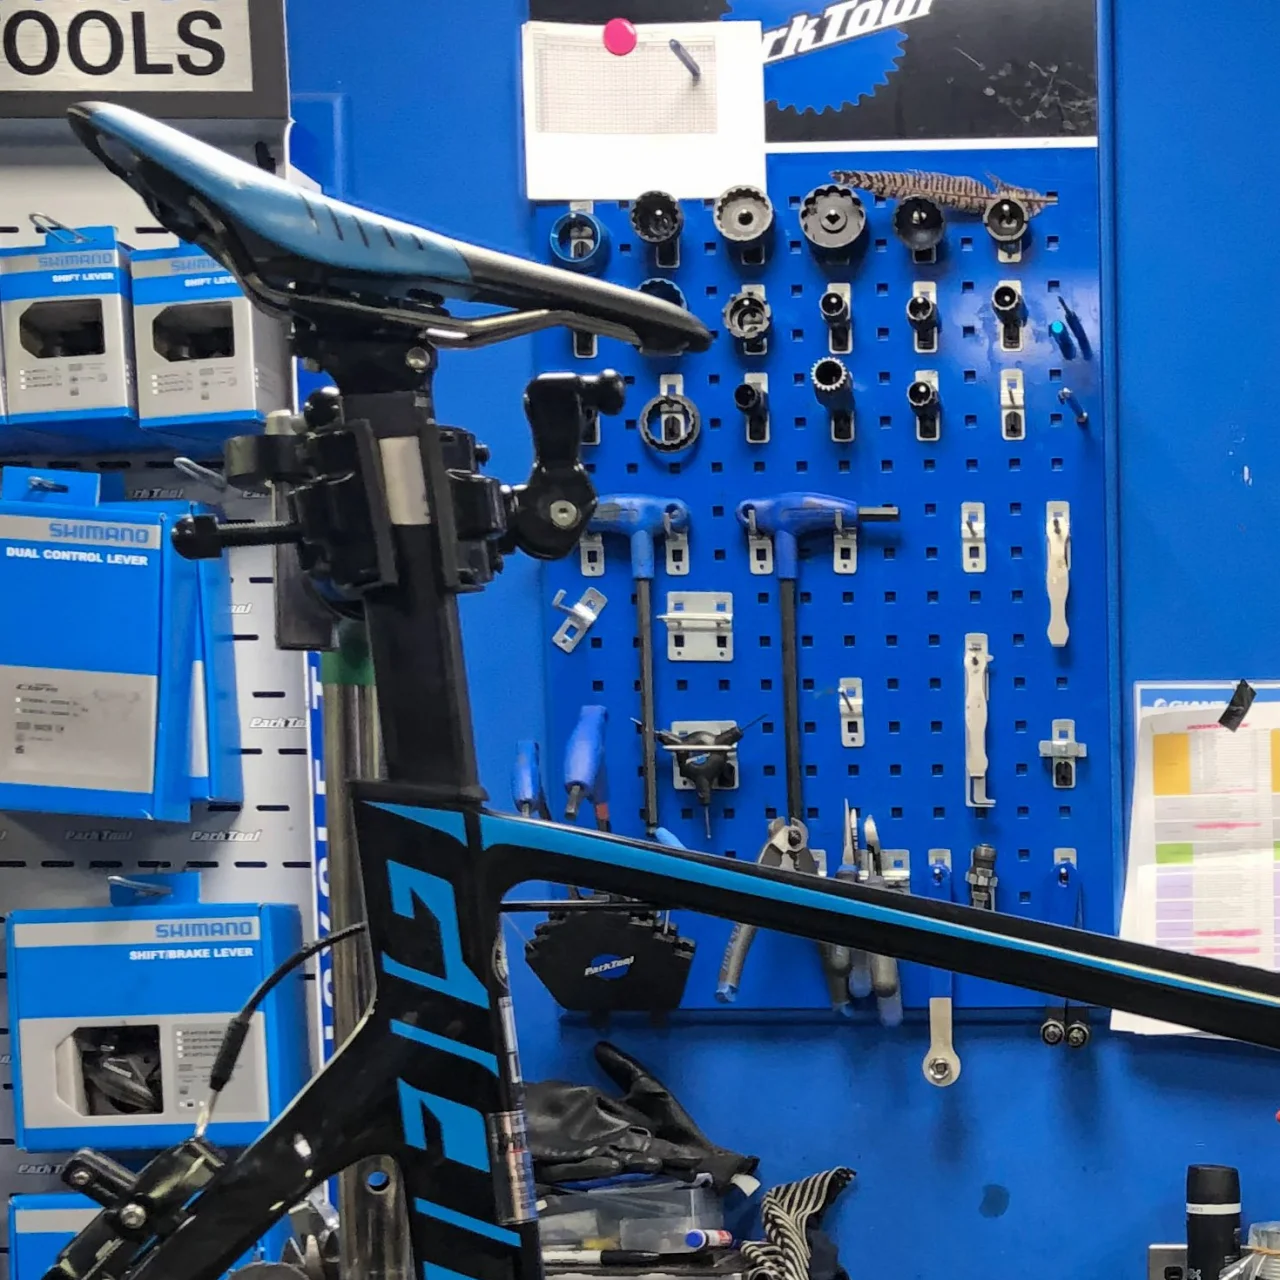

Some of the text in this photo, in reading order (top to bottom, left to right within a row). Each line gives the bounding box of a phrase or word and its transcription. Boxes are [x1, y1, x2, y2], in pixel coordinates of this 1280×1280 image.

[37, 253, 113, 268] SHIMANO
[52, 272, 114, 283] SHIFT LEVER
[184, 278, 212, 287] SHIFT
[50, 523, 149, 543] SHIMANO
[7, 547, 148, 566] DUAL CONTROL LEVER
[155, 921, 253, 938] SHIMANO
[129, 948, 254, 960] SHIFT/BRAKE LEVER
